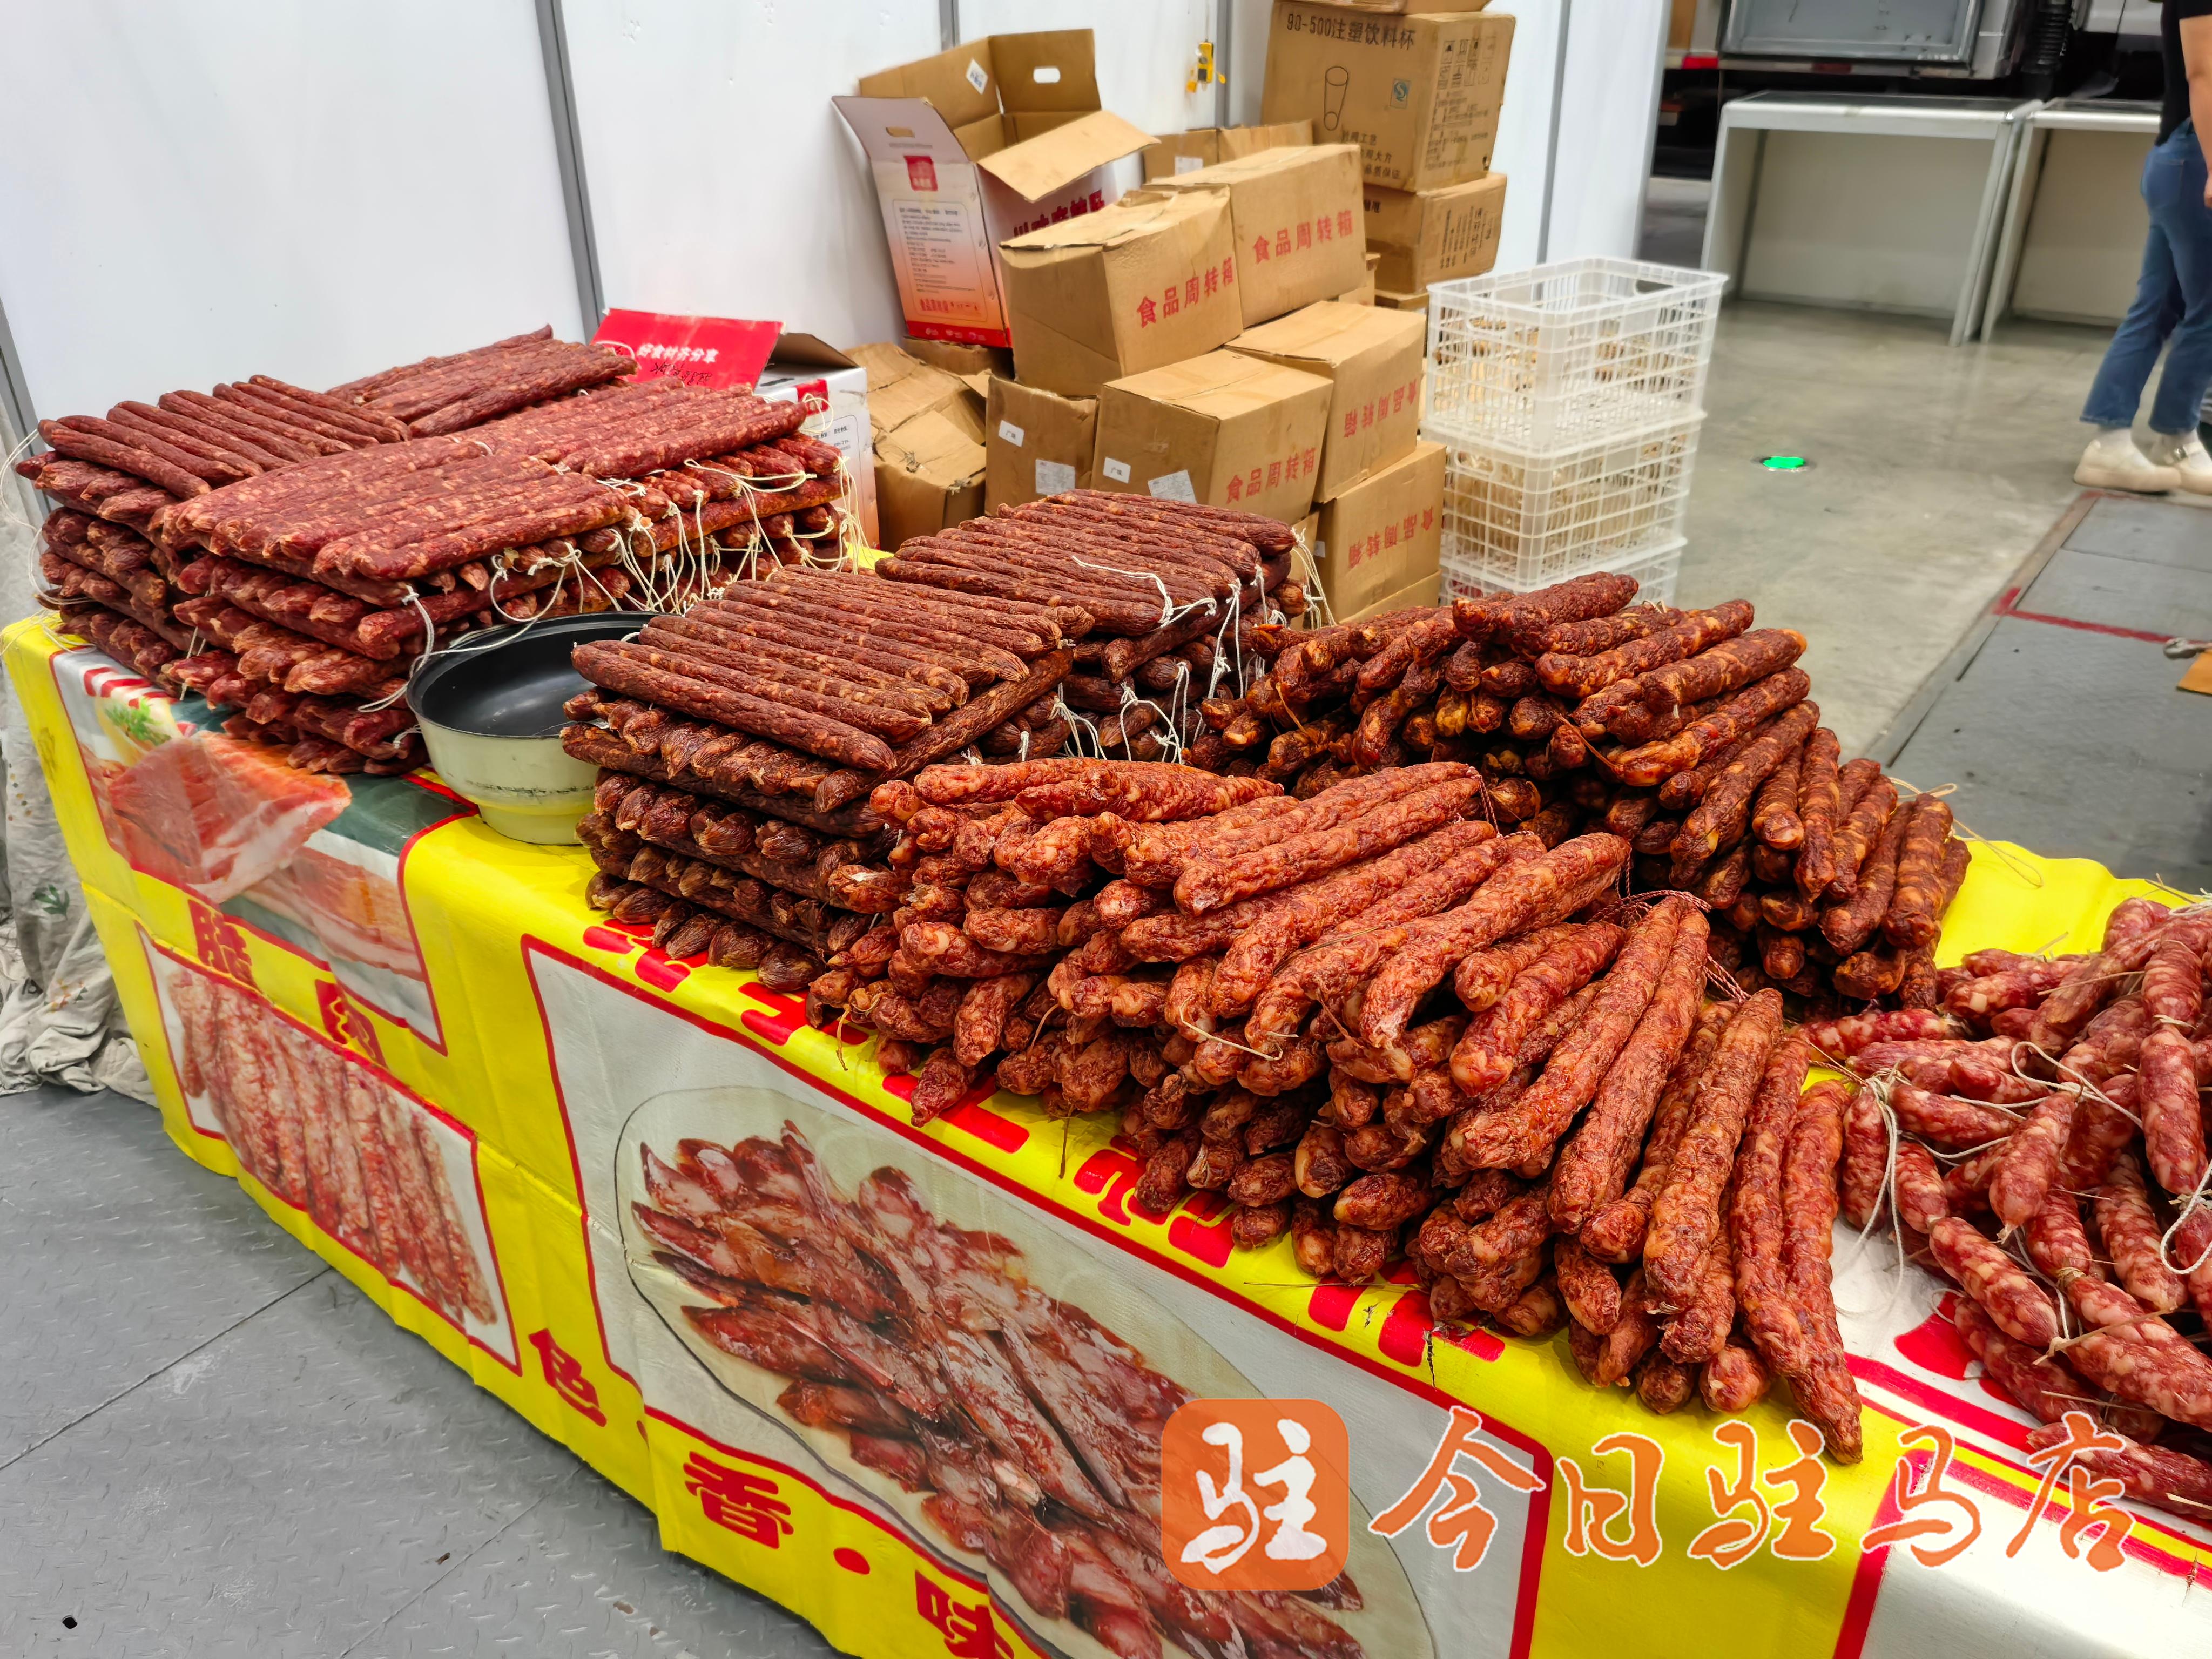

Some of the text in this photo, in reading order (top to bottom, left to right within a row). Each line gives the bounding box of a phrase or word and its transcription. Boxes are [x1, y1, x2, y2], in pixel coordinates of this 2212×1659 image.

[1287, 12, 1415, 50] 90-500注塑饮料杯
[1253, 210, 1353, 264] 食品周转箱
[1136, 257, 1234, 329] 食品周转箱
[1226, 448, 1317, 504] 食品周转箱
